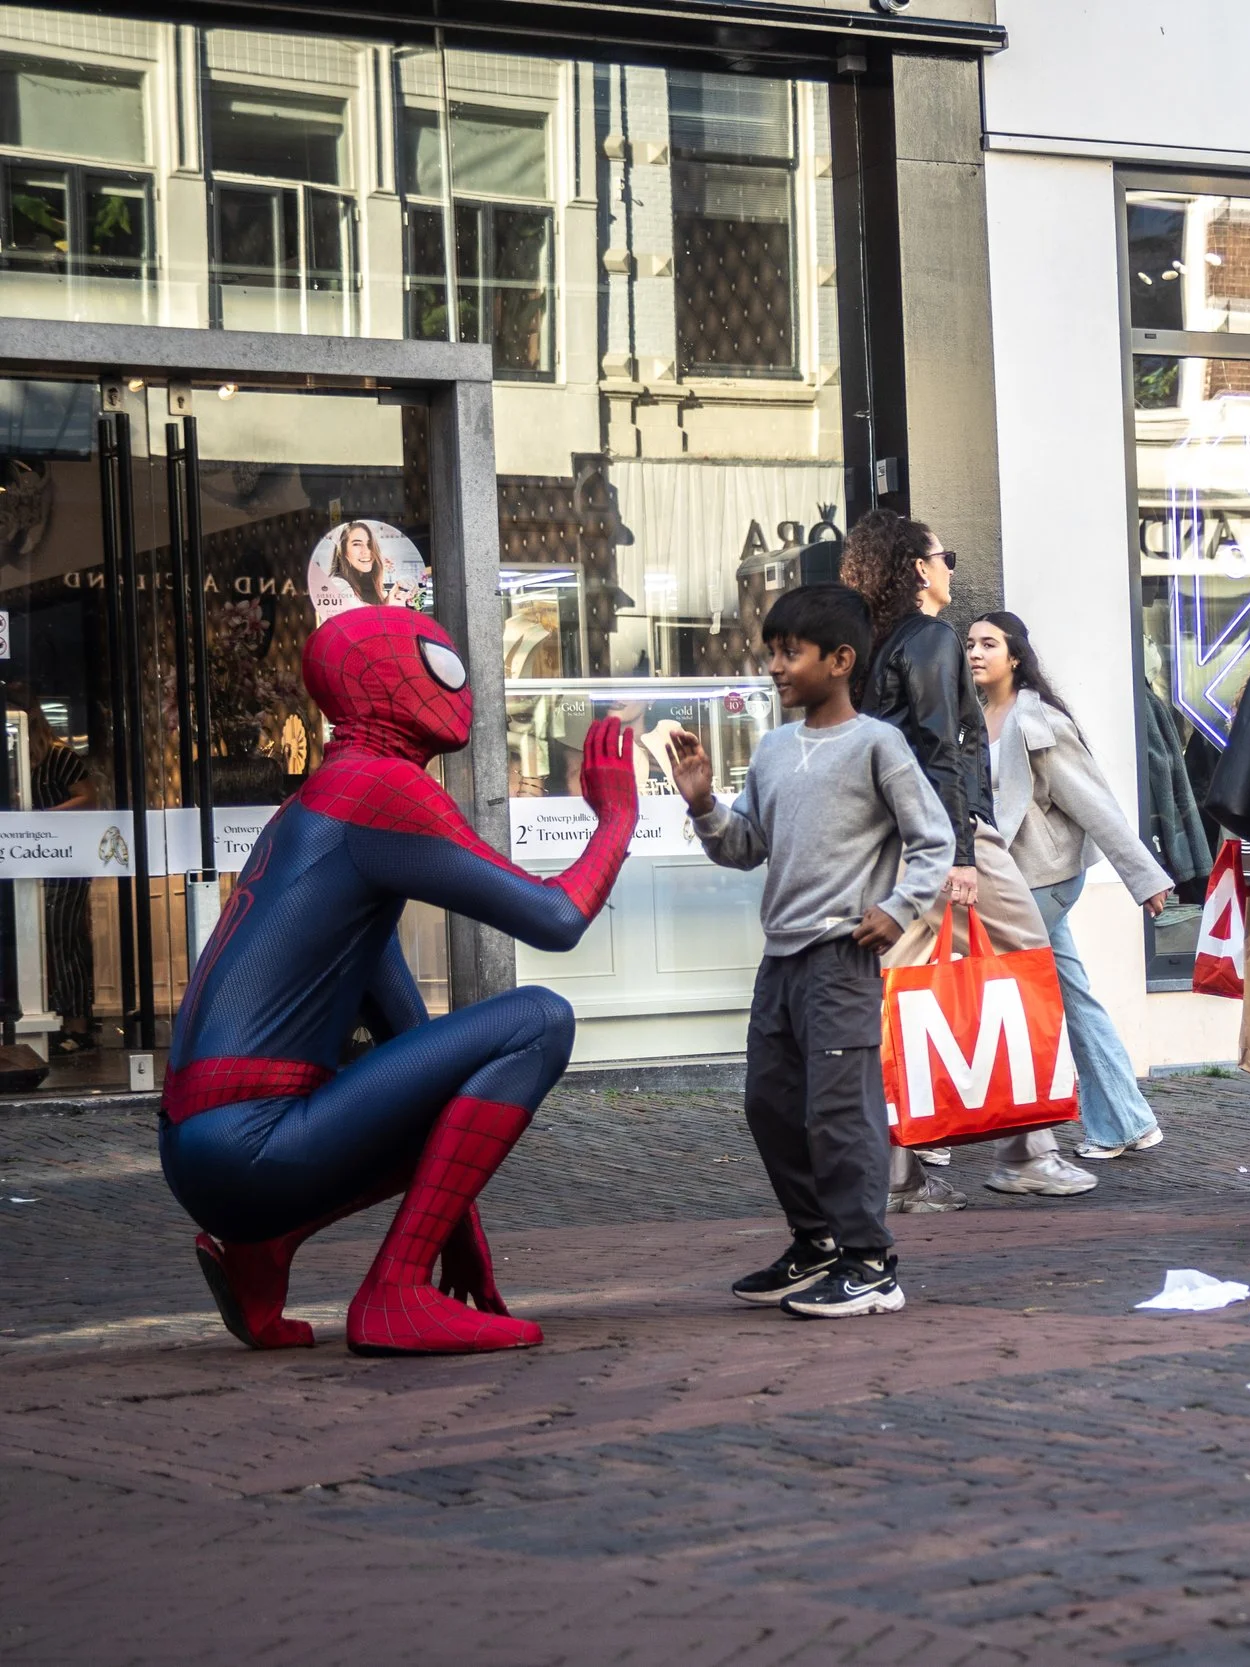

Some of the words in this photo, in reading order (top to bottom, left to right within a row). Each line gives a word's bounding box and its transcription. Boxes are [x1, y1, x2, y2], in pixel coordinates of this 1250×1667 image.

[561, 701, 585, 713] Gold
[670, 705, 693, 716] Gold
[536, 814, 571, 824] Ontwerp
[224, 825, 263, 835] Ontwerp
[10, 844, 73, 859] Cadeau!
[224, 841, 253, 853] Tro
